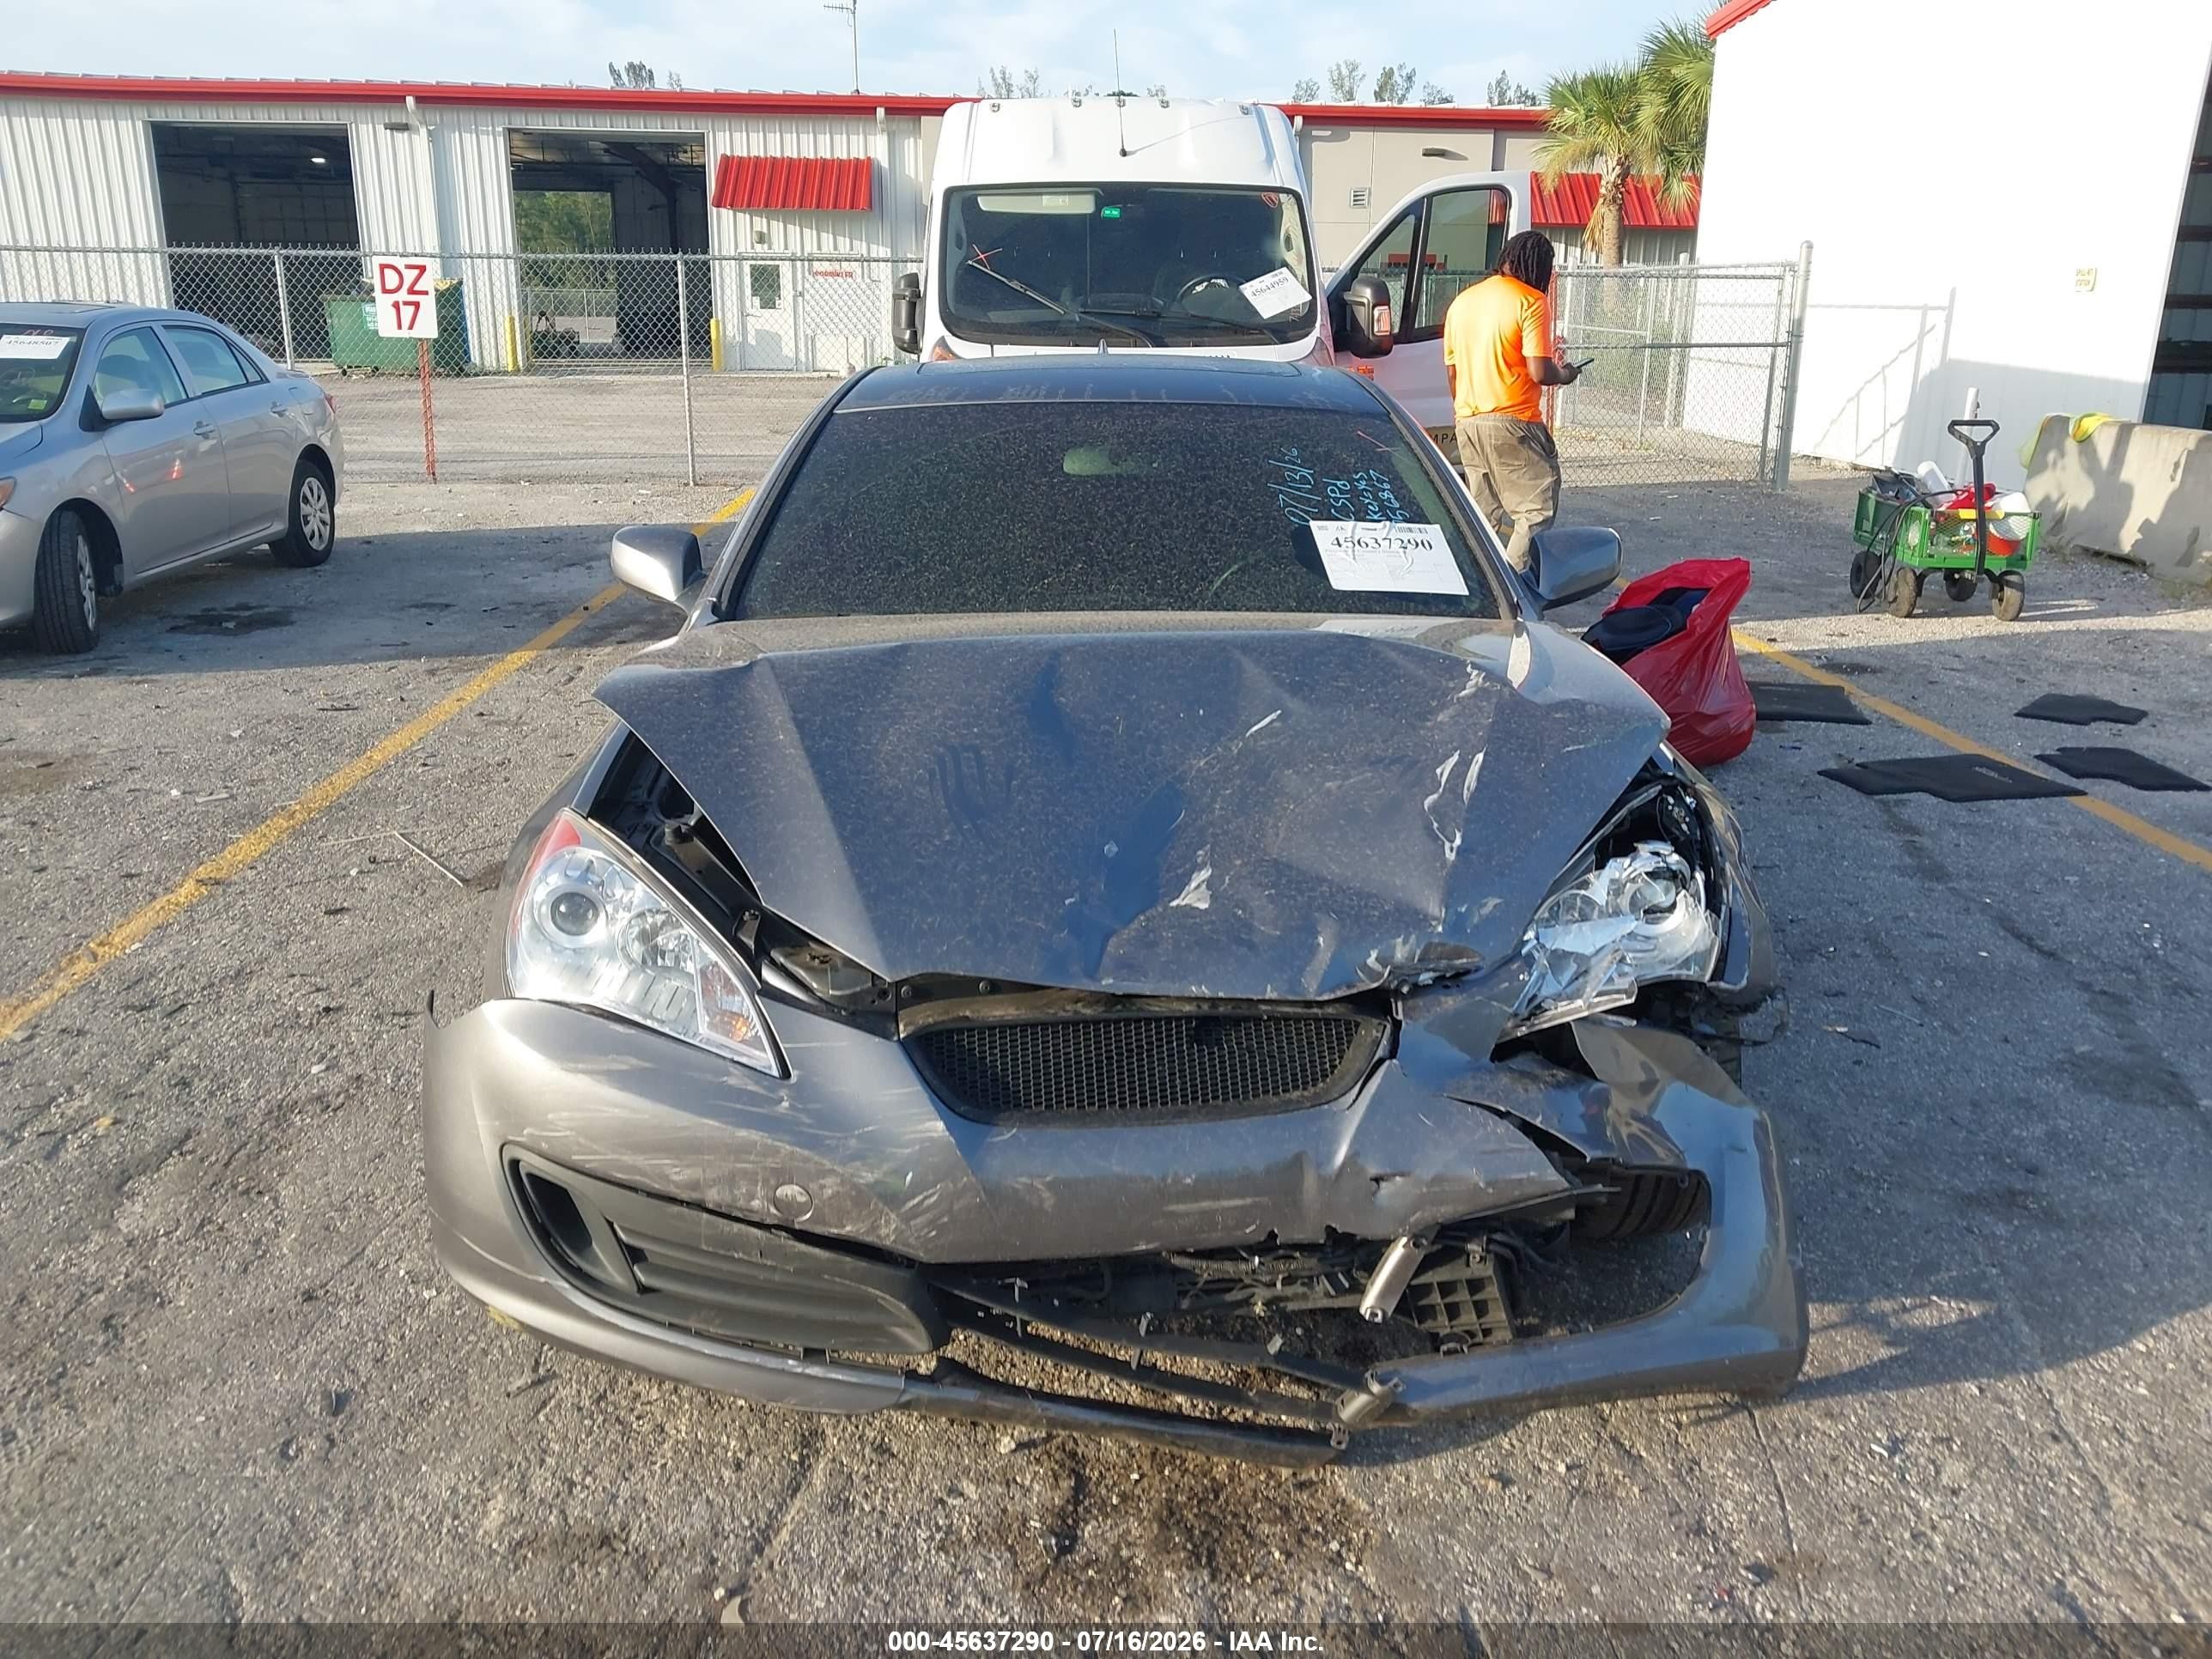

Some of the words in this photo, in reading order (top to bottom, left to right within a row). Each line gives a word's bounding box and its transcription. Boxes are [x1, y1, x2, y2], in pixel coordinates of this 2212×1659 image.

[379, 263, 429, 295] DZ
[391, 301, 421, 331] 17
[1267, 447, 1322, 526] 07/13/26
[1331, 536, 1433, 551] 45637290
